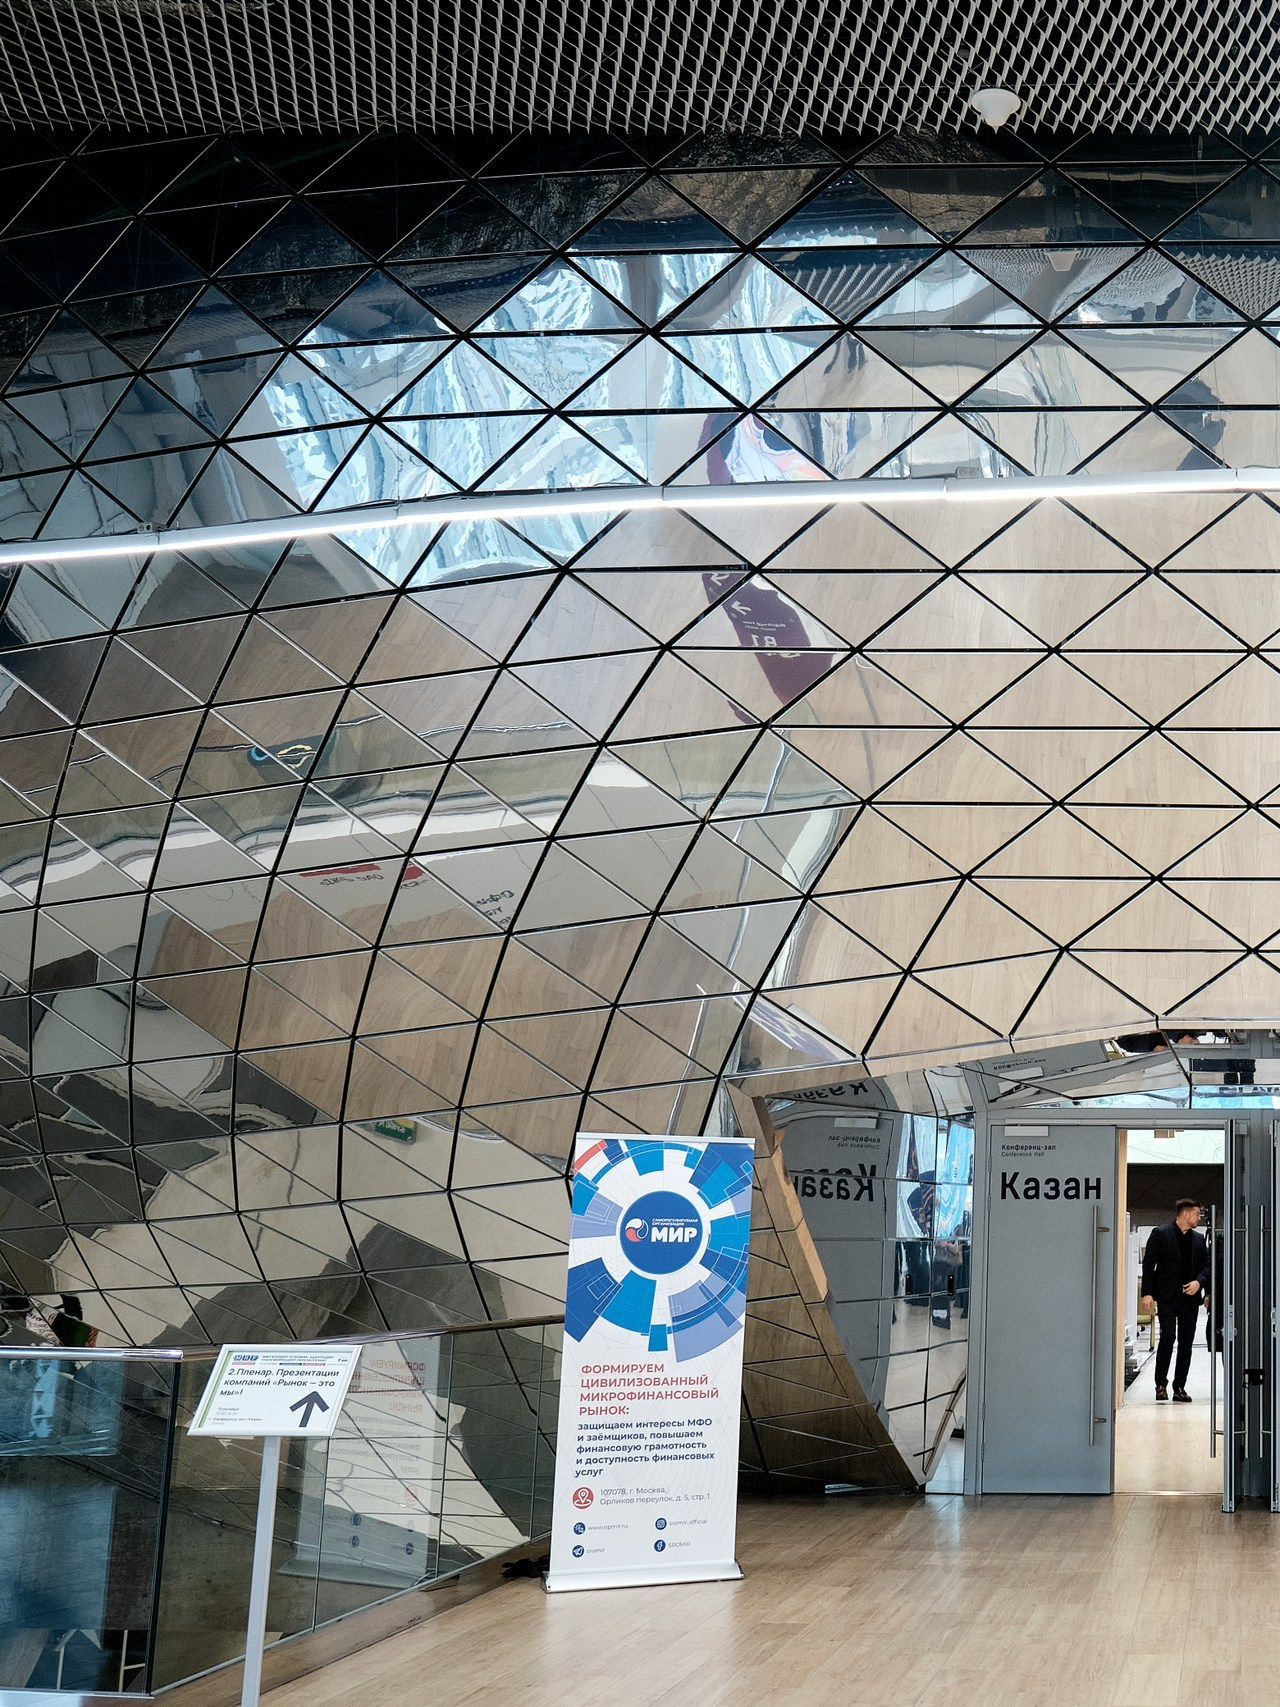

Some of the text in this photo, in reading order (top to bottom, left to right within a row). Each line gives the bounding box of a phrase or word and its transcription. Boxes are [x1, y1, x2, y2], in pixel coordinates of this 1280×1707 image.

[1001, 1144, 1056, 1152] Конференц-зал
[1001, 1171, 1102, 1200] Казан
[650, 1227, 698, 1243] МИР
[275, 1368, 340, 1378] Презентации
[581, 1363, 665, 1375] ФОРМИРУЕМ
[223, 1378, 271, 1386] компаний
[272, 1378, 308, 1387] «Рынок
[580, 1375, 708, 1388] ЦИВИЛИЗОВАННЫЙ
[579, 1388, 719, 1402] МИКРОФИНАНСОВЫЙ
[578, 1405, 630, 1416] РЫНОК:
[577, 1418, 713, 1431] защищаем интересы МФО
[586, 1431, 648, 1443] заёмщиков,
[649, 1430, 704, 1439] повышаем
[576, 1441, 707, 1455] финансовую грамотность
[585, 1454, 650, 1466] доступность
[652, 1451, 715, 1463] финансовых
[575, 1468, 604, 1479] услуг
[636, 1486, 667, 1495] Москва,
[691, 1493, 705, 1502] стр.
